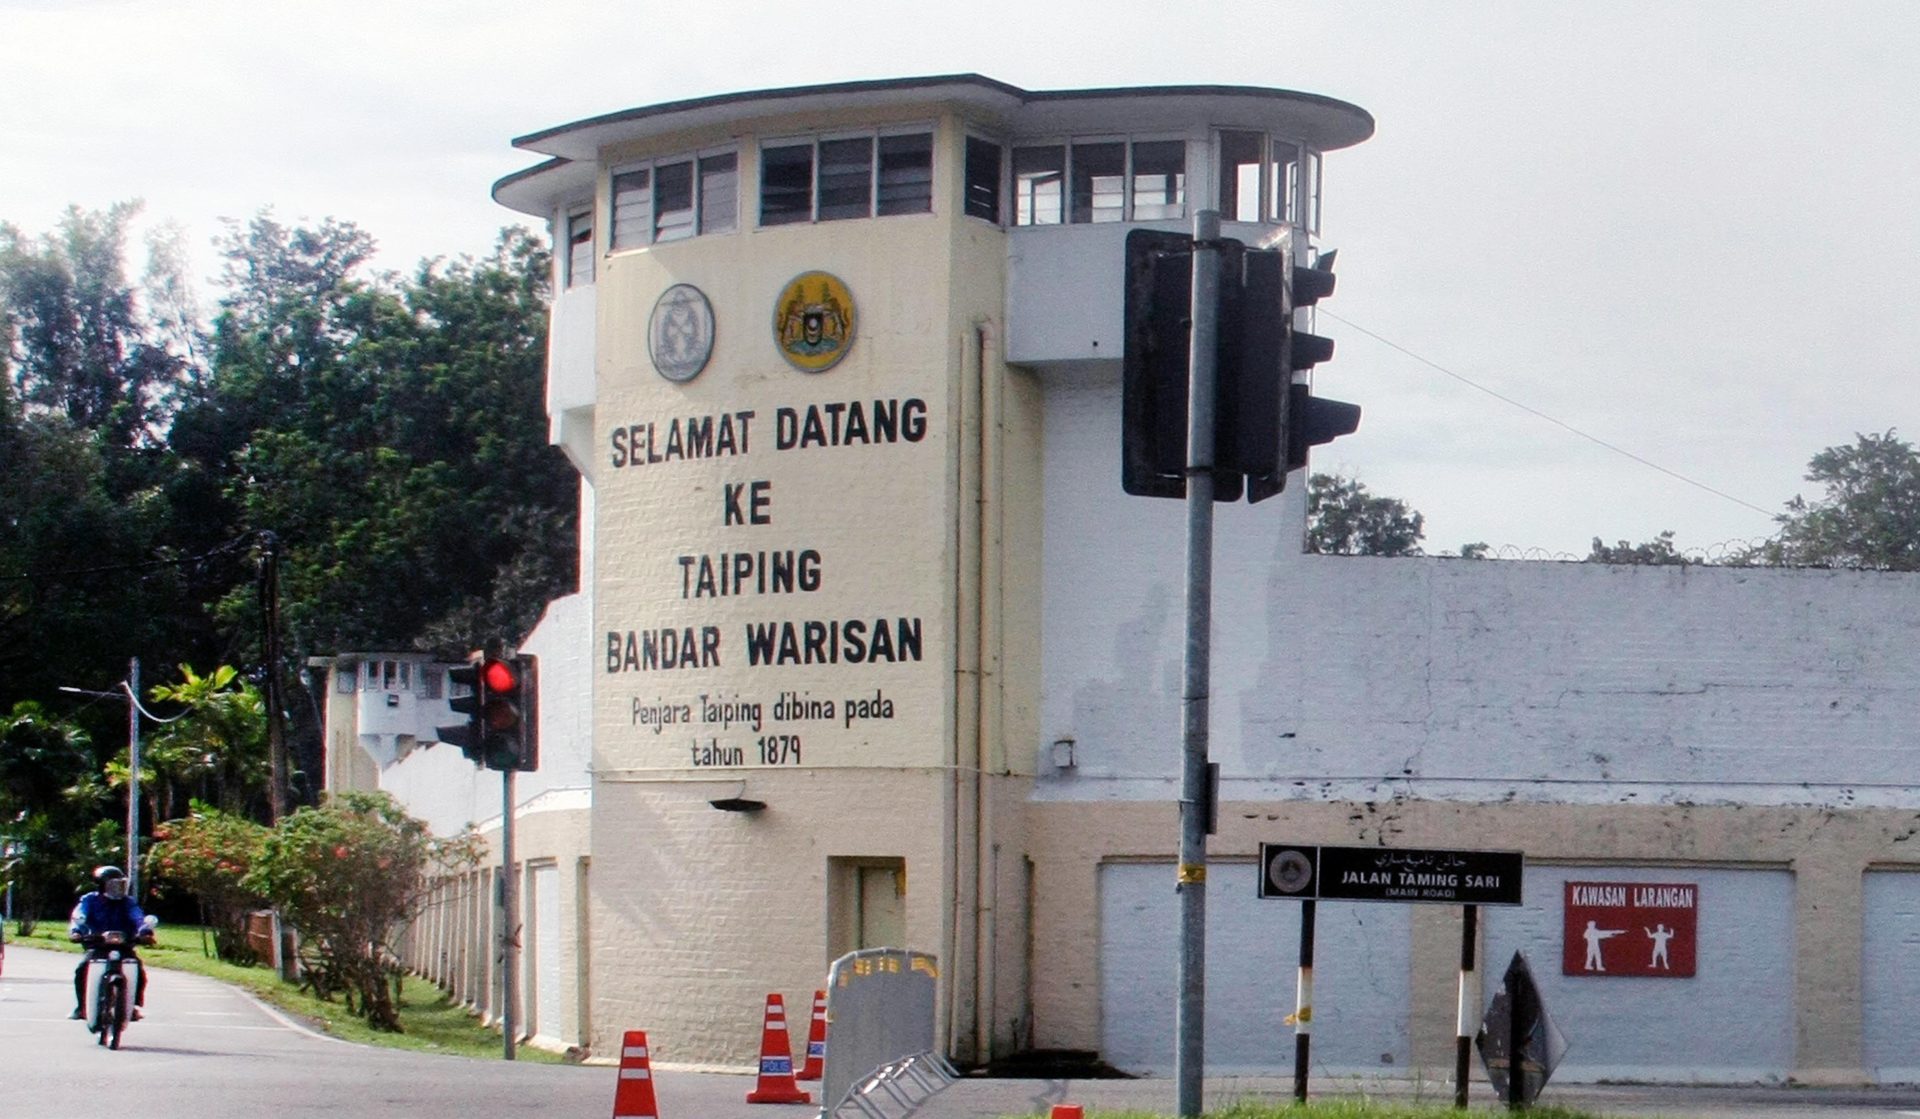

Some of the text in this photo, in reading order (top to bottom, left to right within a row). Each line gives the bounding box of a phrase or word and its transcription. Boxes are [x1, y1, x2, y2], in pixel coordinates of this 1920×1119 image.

[612, 398, 928, 468] SELAMAT DATANG
[724, 481, 771, 526] KE
[678, 549, 822, 599] TAIPING
[606, 617, 923, 674] BANDAR WARISAN
[632, 689, 894, 735] Penjara Taiping dibina pada
[691, 735, 801, 767] tahun 1879
[1341, 871, 1500, 889] JALAN TAMING SARI
[1385, 887, 1456, 899] (MAIN ROAD)
[1572, 885, 1694, 909] KAWASAN LARANGAN
[762, 1061, 789, 1072] POLIS
